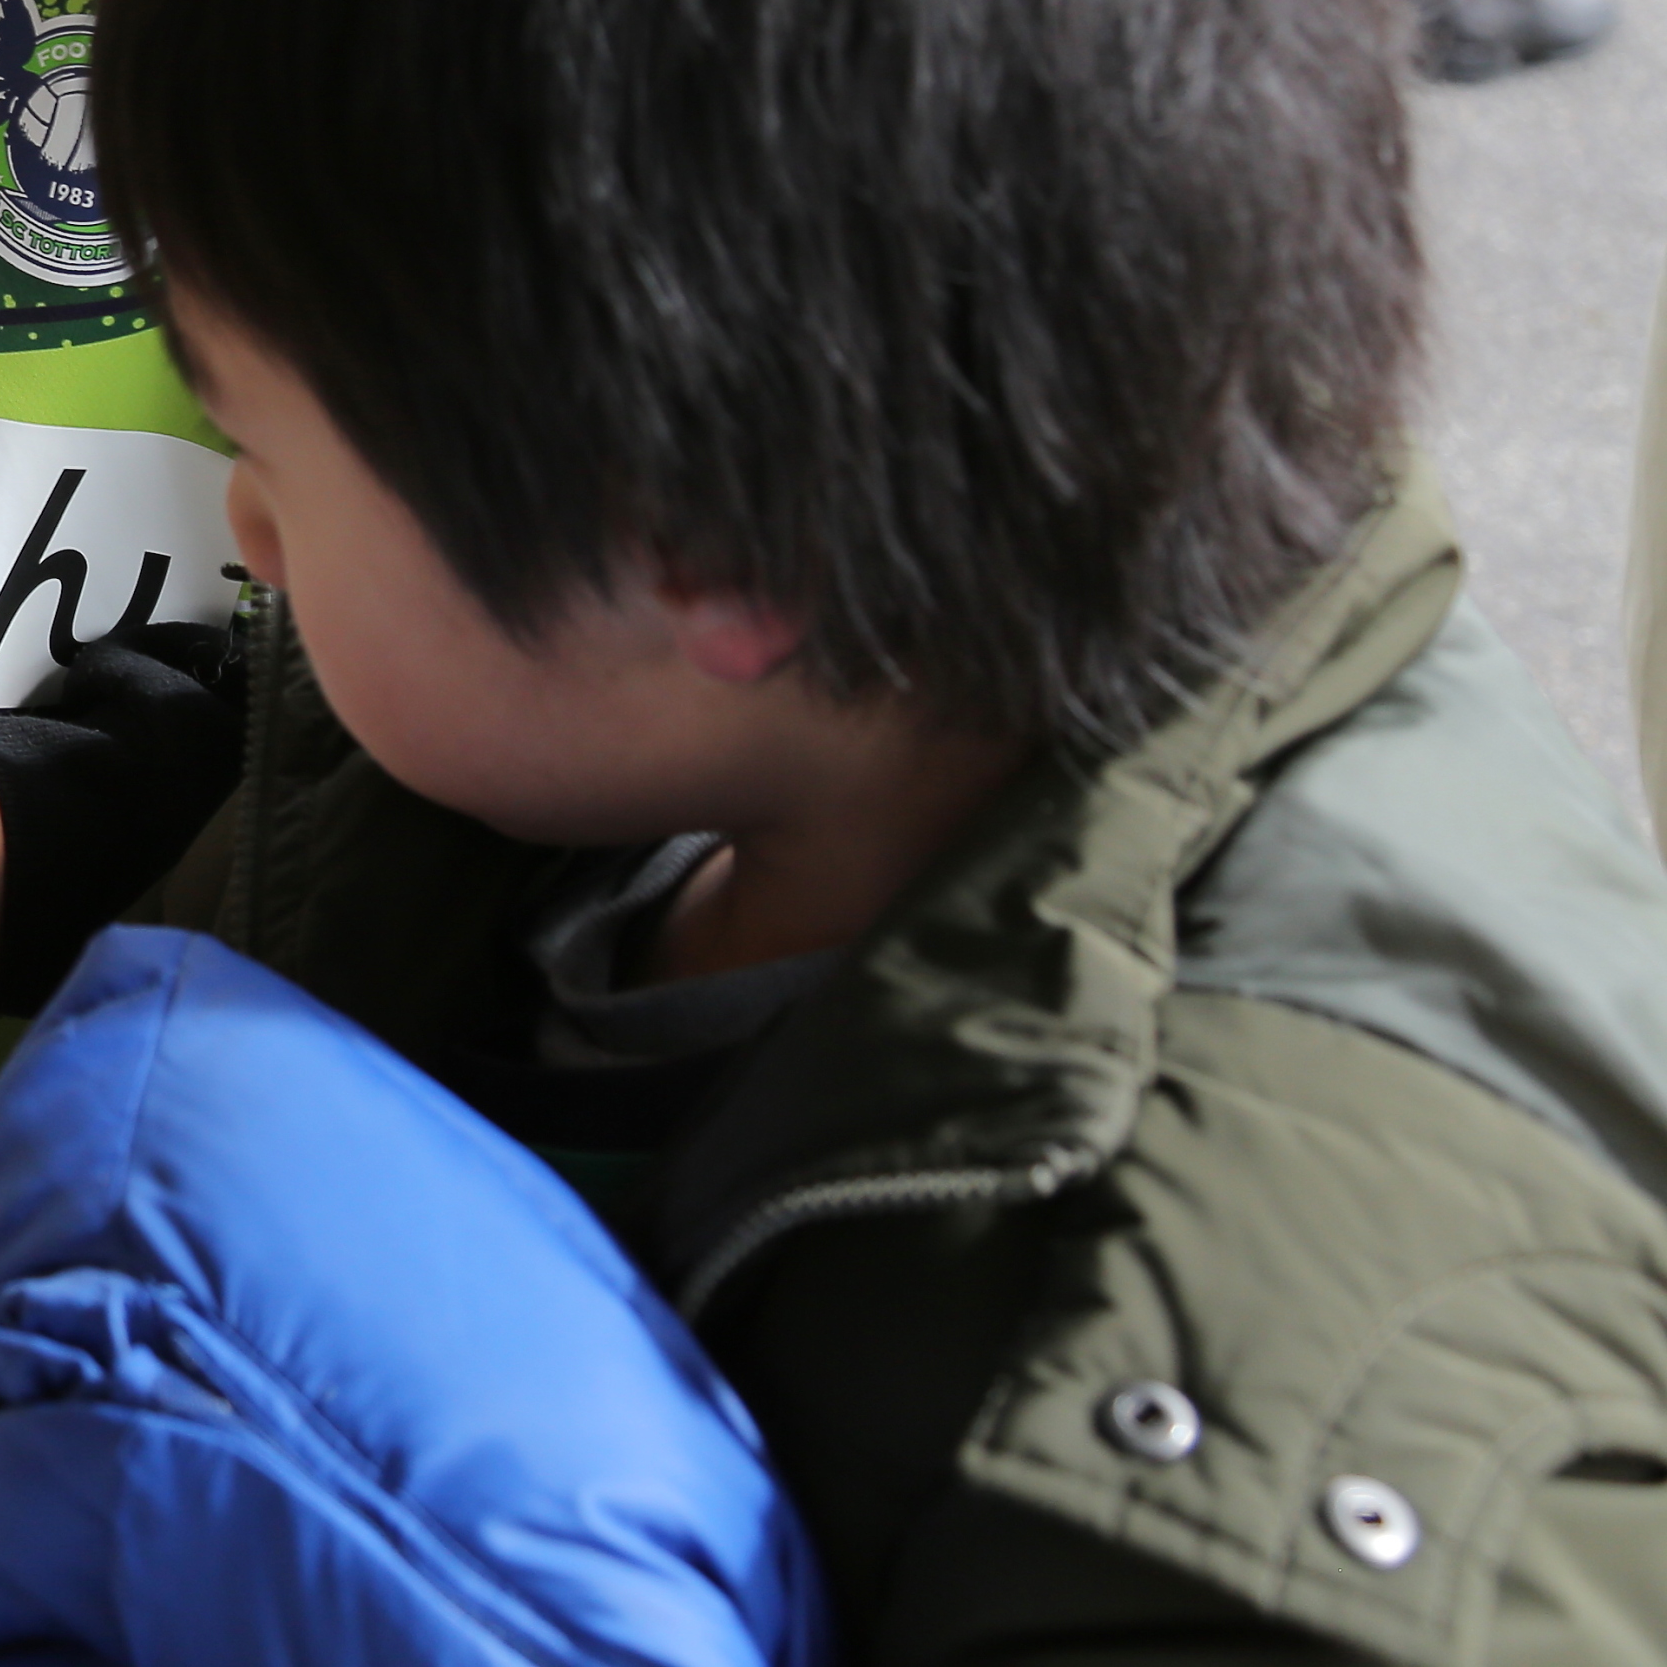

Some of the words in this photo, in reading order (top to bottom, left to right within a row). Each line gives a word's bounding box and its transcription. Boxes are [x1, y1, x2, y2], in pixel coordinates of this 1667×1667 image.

[36, 41, 92, 68] FOO
[48, 181, 96, 209] 1983
[0, 209, 26, 240] SC
